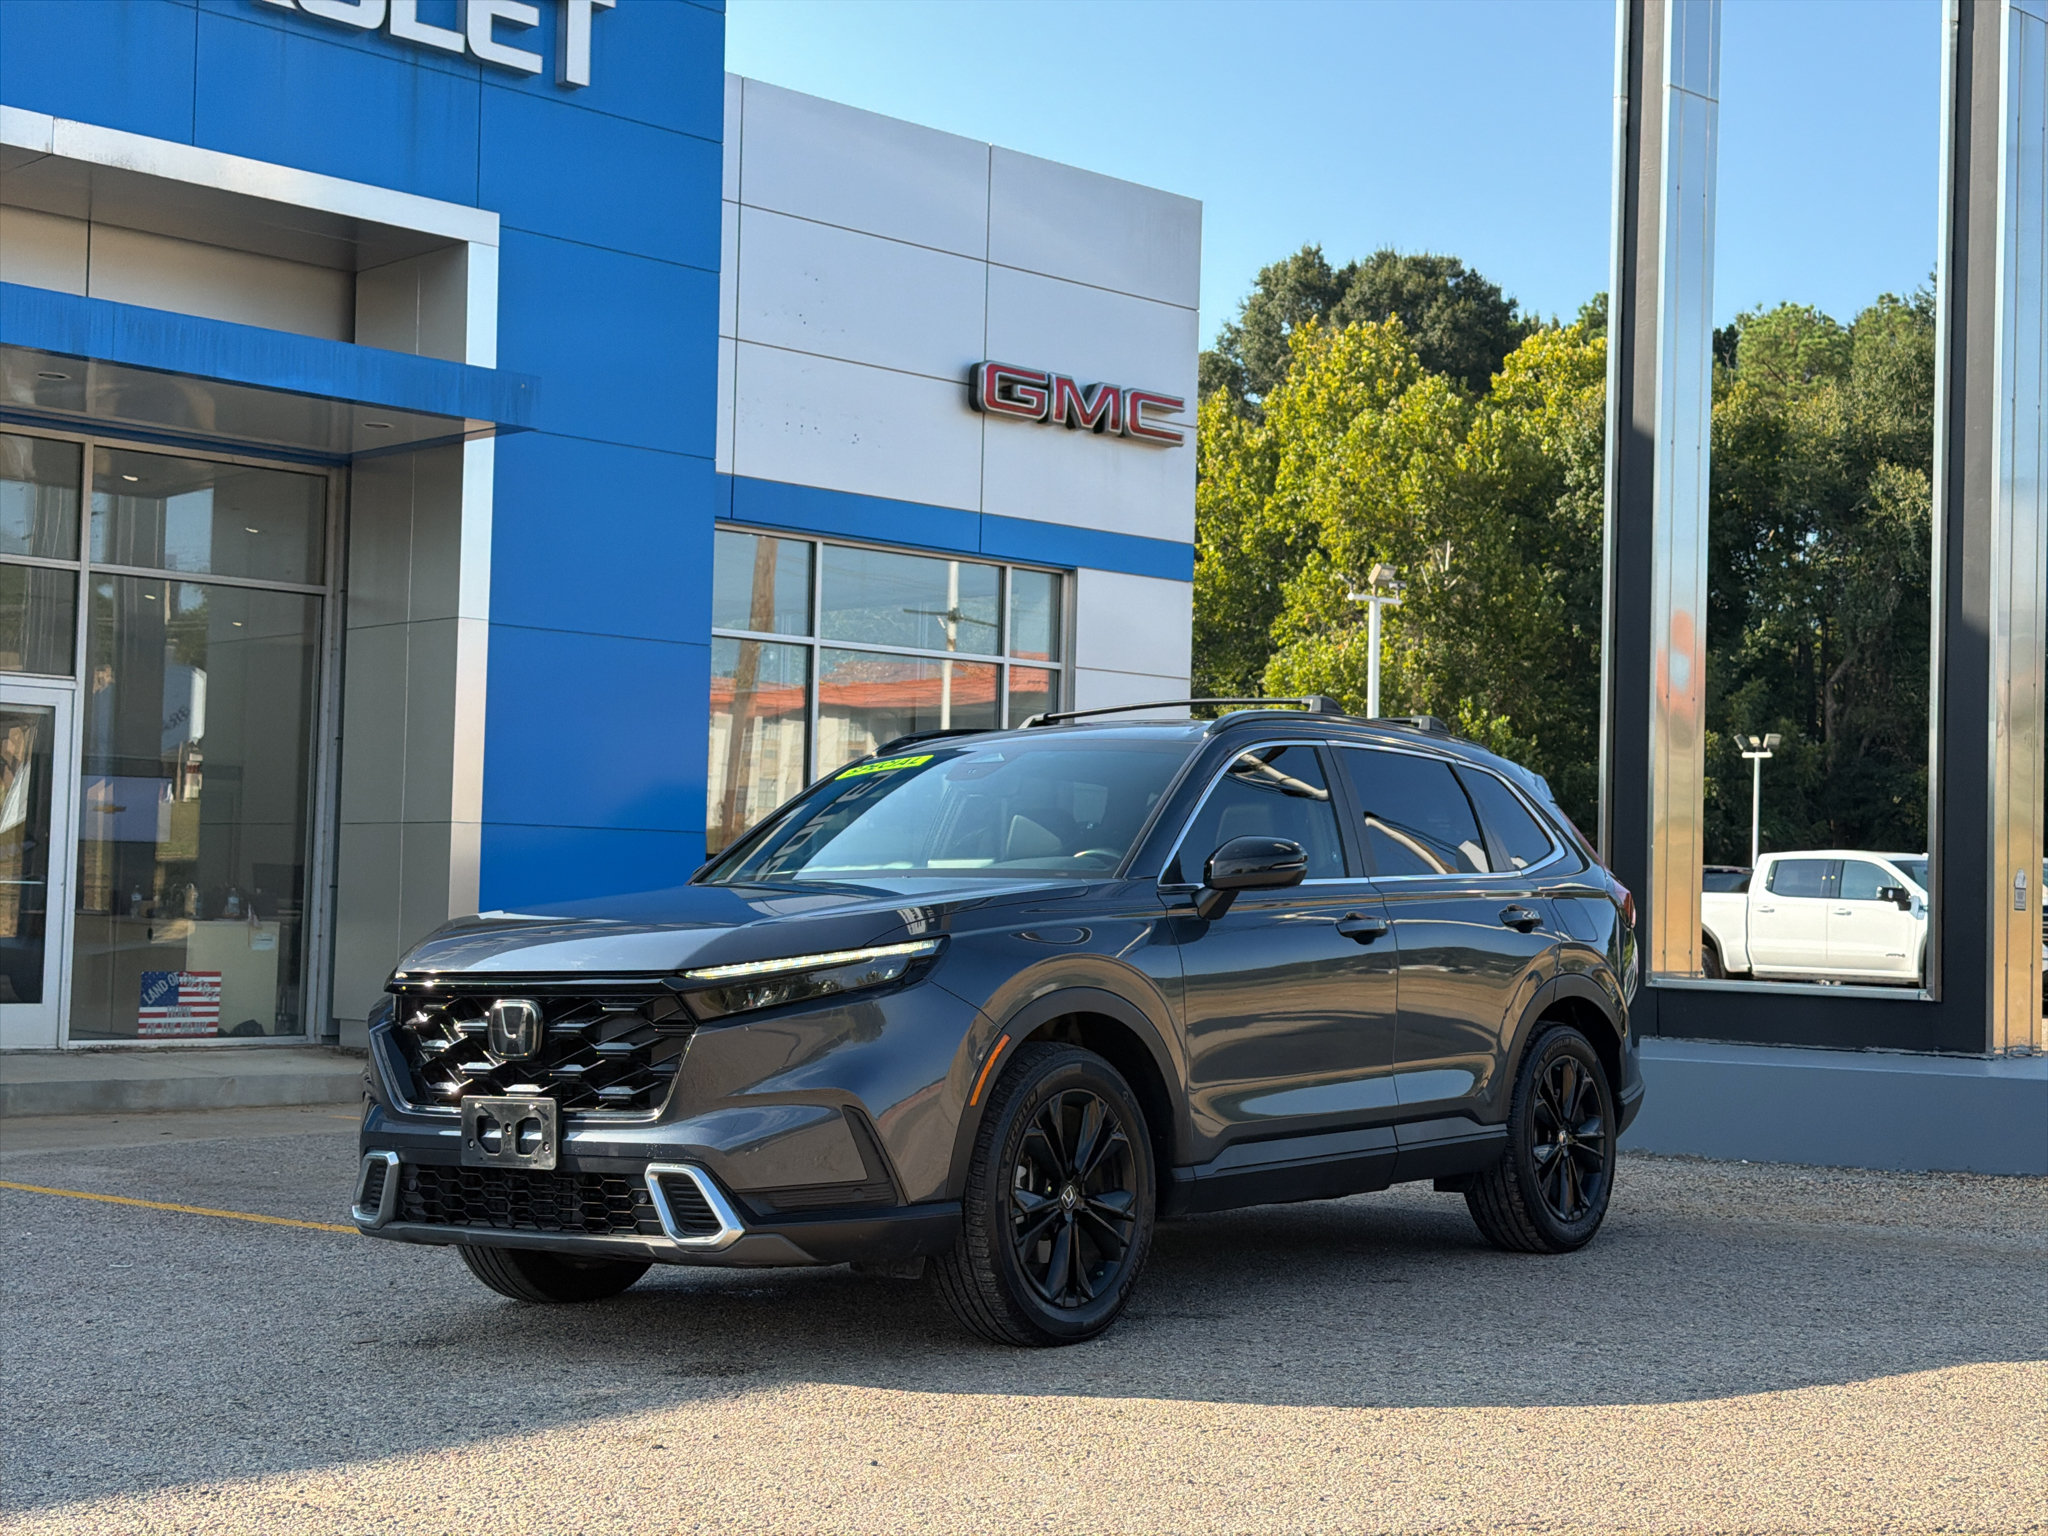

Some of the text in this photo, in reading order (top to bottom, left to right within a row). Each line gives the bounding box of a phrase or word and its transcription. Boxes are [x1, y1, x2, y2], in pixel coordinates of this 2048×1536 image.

[971, 360, 1185, 447] GMC
[142, 980, 168, 1004] LAND
[167, 971, 180, 986] OF
